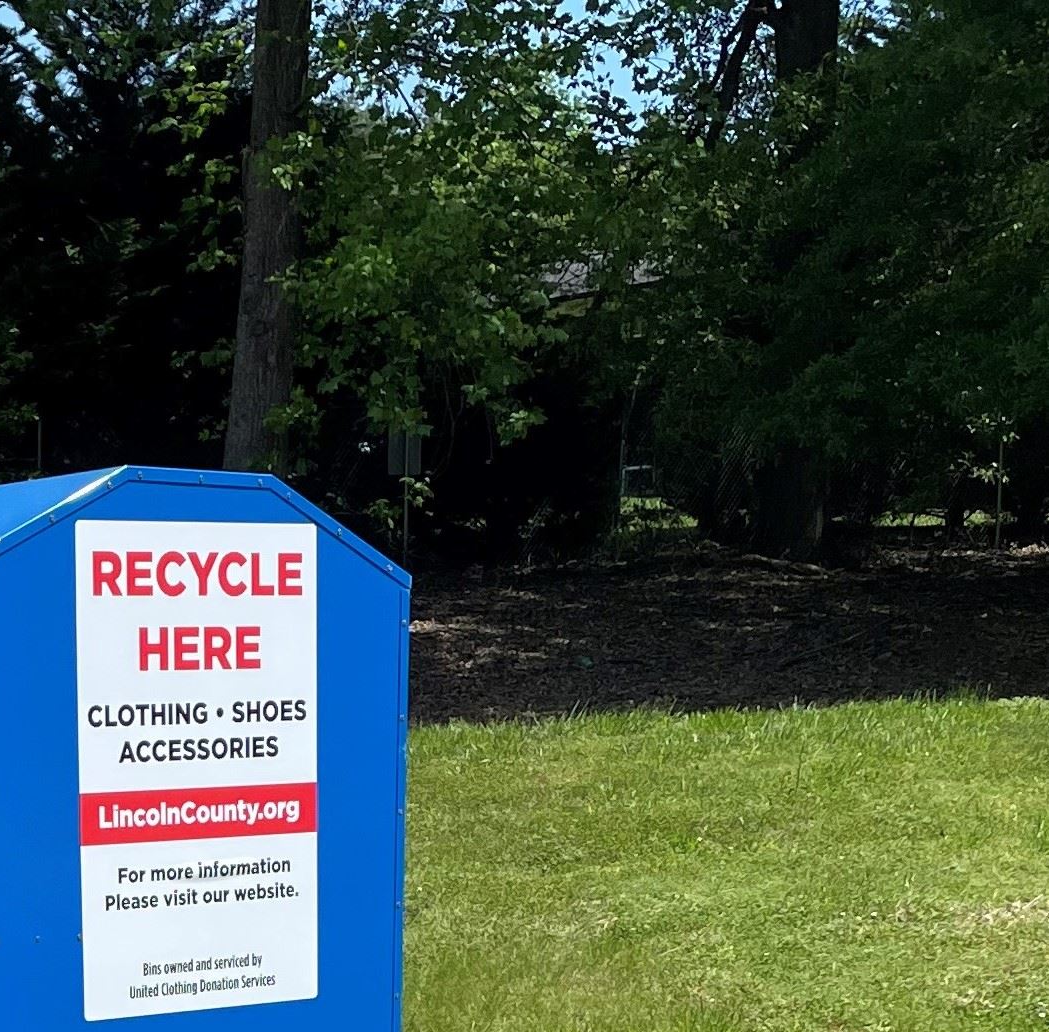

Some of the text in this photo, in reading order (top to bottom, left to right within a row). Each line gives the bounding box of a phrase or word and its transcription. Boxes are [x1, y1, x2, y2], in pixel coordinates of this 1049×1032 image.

[92, 550, 303, 597] RECYCLE
[138, 626, 261, 671] HERE
[87, 699, 307, 728] CLOTHING SHOES
[118, 735, 279, 763] ACCESSORIES
[98, 799, 300, 829] LincolnCounty.org
[117, 857, 291, 884] For more information
[105, 882, 299, 911] Please visit our website.
[143, 953, 263, 976] Bins owned and serviced by
[129, 973, 276, 999] United Clothing Donation Services
